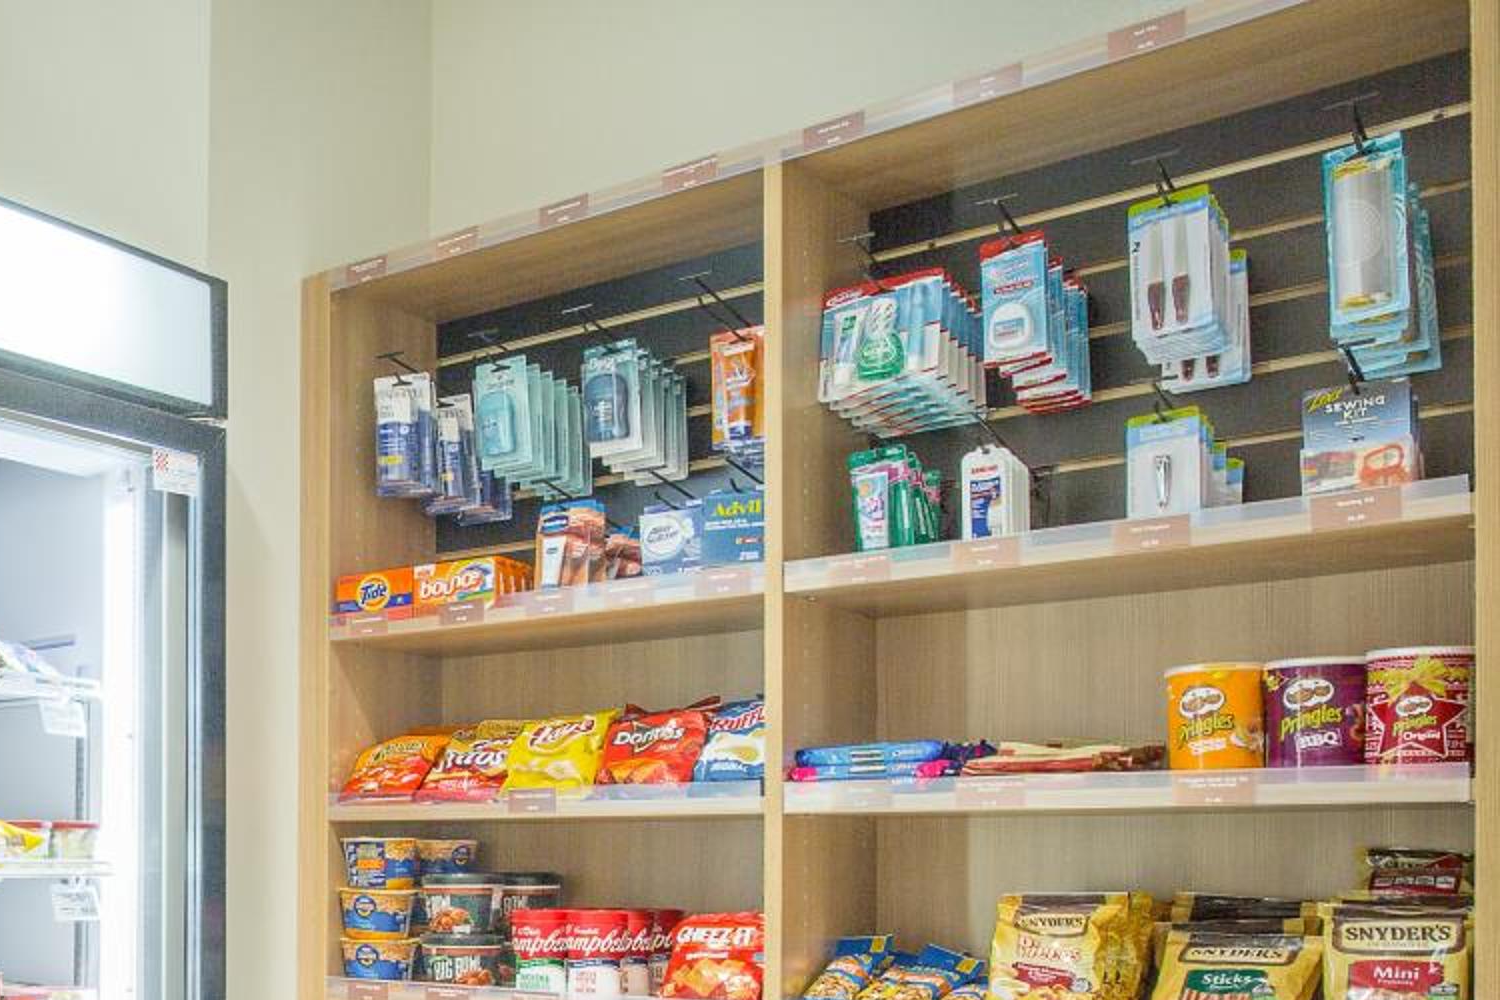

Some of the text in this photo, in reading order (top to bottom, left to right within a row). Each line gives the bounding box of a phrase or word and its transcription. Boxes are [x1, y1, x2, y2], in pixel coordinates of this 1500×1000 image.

[1325, 395, 1385, 413] SEWING
[1342, 407, 1368, 419] KIT
[711, 499, 761, 518] Advil
[358, 582, 387, 606] Tide
[420, 571, 482, 600] bounce
[712, 708, 764, 731] RUFFL
[1279, 705, 1343, 742] Pringles
[1392, 713, 1437, 738] Pringles
[613, 724, 685, 746] Doritos
[1178, 713, 1235, 749] Pringles
[1402, 730, 1441, 741] Original
[1344, 923, 1452, 942] SNYDER'S
[434, 958, 453, 981] BIG
[1201, 973, 1253, 986] Sticks
[1372, 965, 1421, 981] Mini
